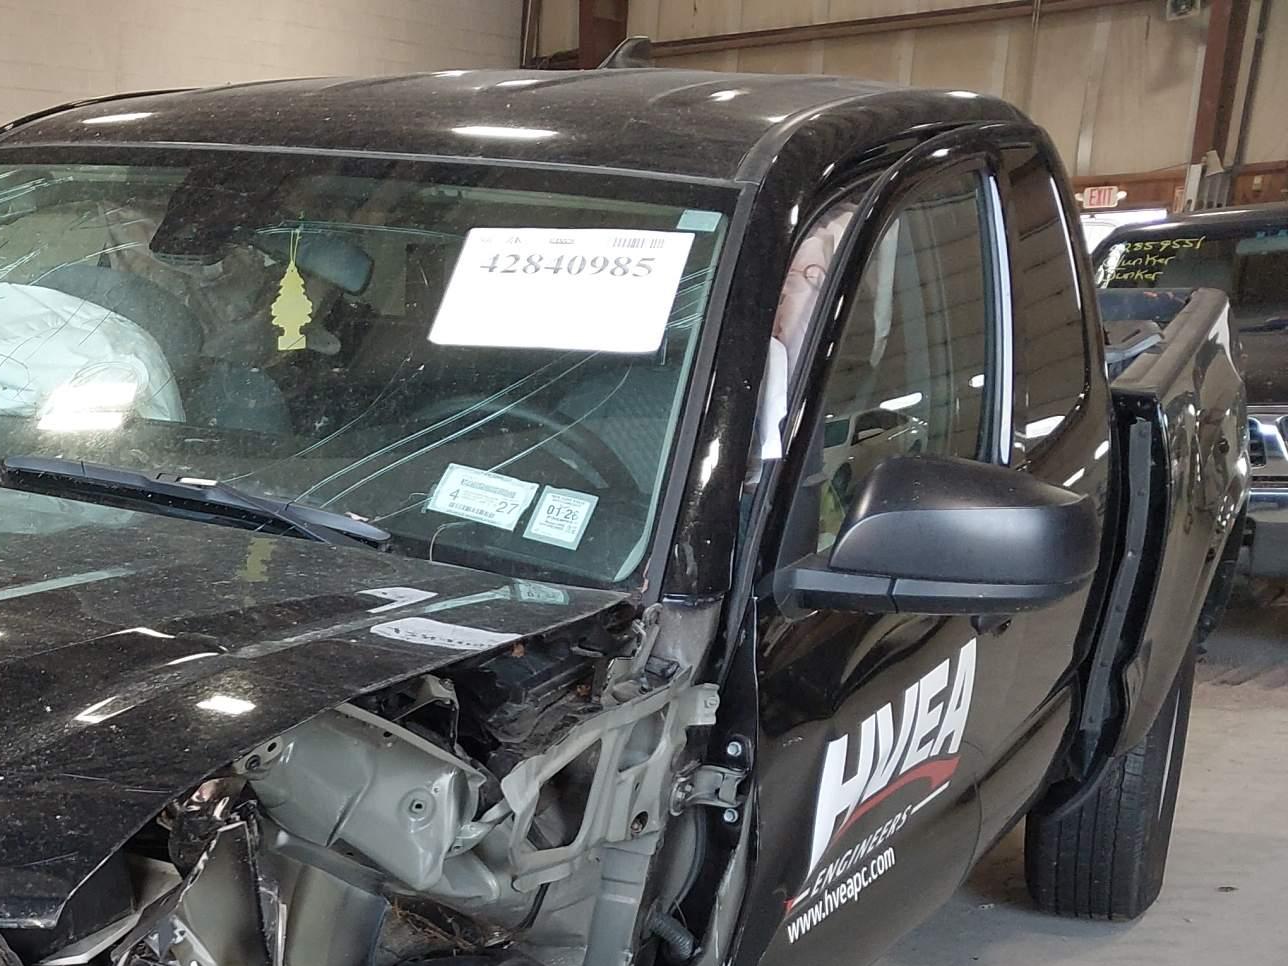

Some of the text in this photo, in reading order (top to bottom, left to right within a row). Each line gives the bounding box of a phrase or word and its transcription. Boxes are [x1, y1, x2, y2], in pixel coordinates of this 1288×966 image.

[1088, 188, 1113, 207] EXIT
[479, 253, 656, 278] 42840985
[449, 488, 461, 501] 4
[495, 501, 520, 515] 27
[806, 636, 977, 880] HVEA
[811, 805, 912, 898] ENGINEERS
[787, 846, 896, 944] www.hveapc.com
